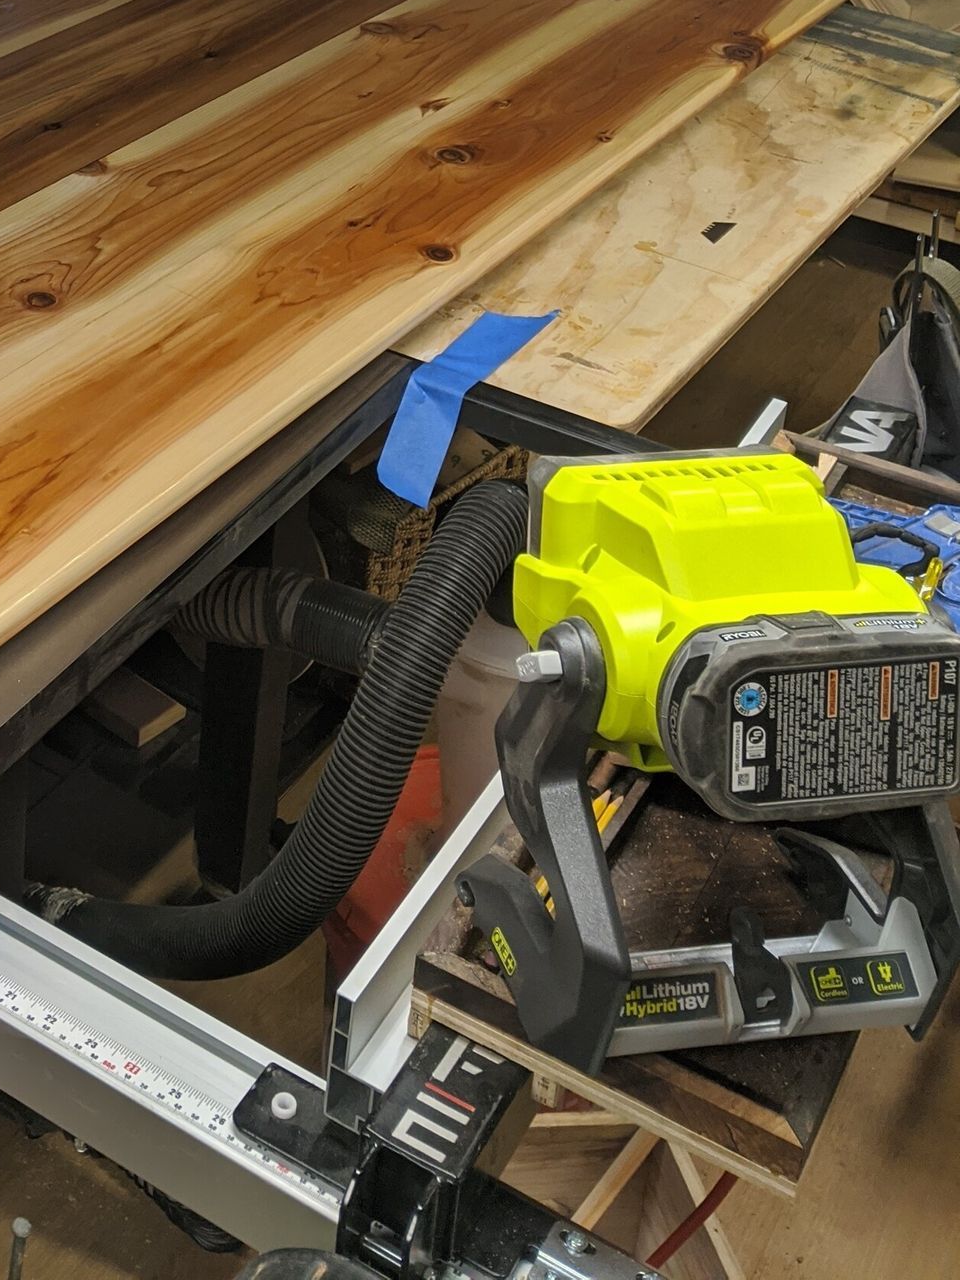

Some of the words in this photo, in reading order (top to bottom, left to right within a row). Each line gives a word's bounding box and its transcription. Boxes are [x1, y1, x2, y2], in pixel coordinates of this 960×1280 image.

[944, 659, 956, 685] P107
[851, 975, 865, 986] OR
[876, 981, 904, 993] Electric
[642, 980, 710, 999] Lithium
[820, 988, 848, 998] Cordless
[4, 990, 18, 1001] 21
[43, 1014, 58, 1025] 22
[84, 1038, 99, 1049] 23
[168, 1088, 182, 1099] 25
[212, 1113, 227, 1125] 26
